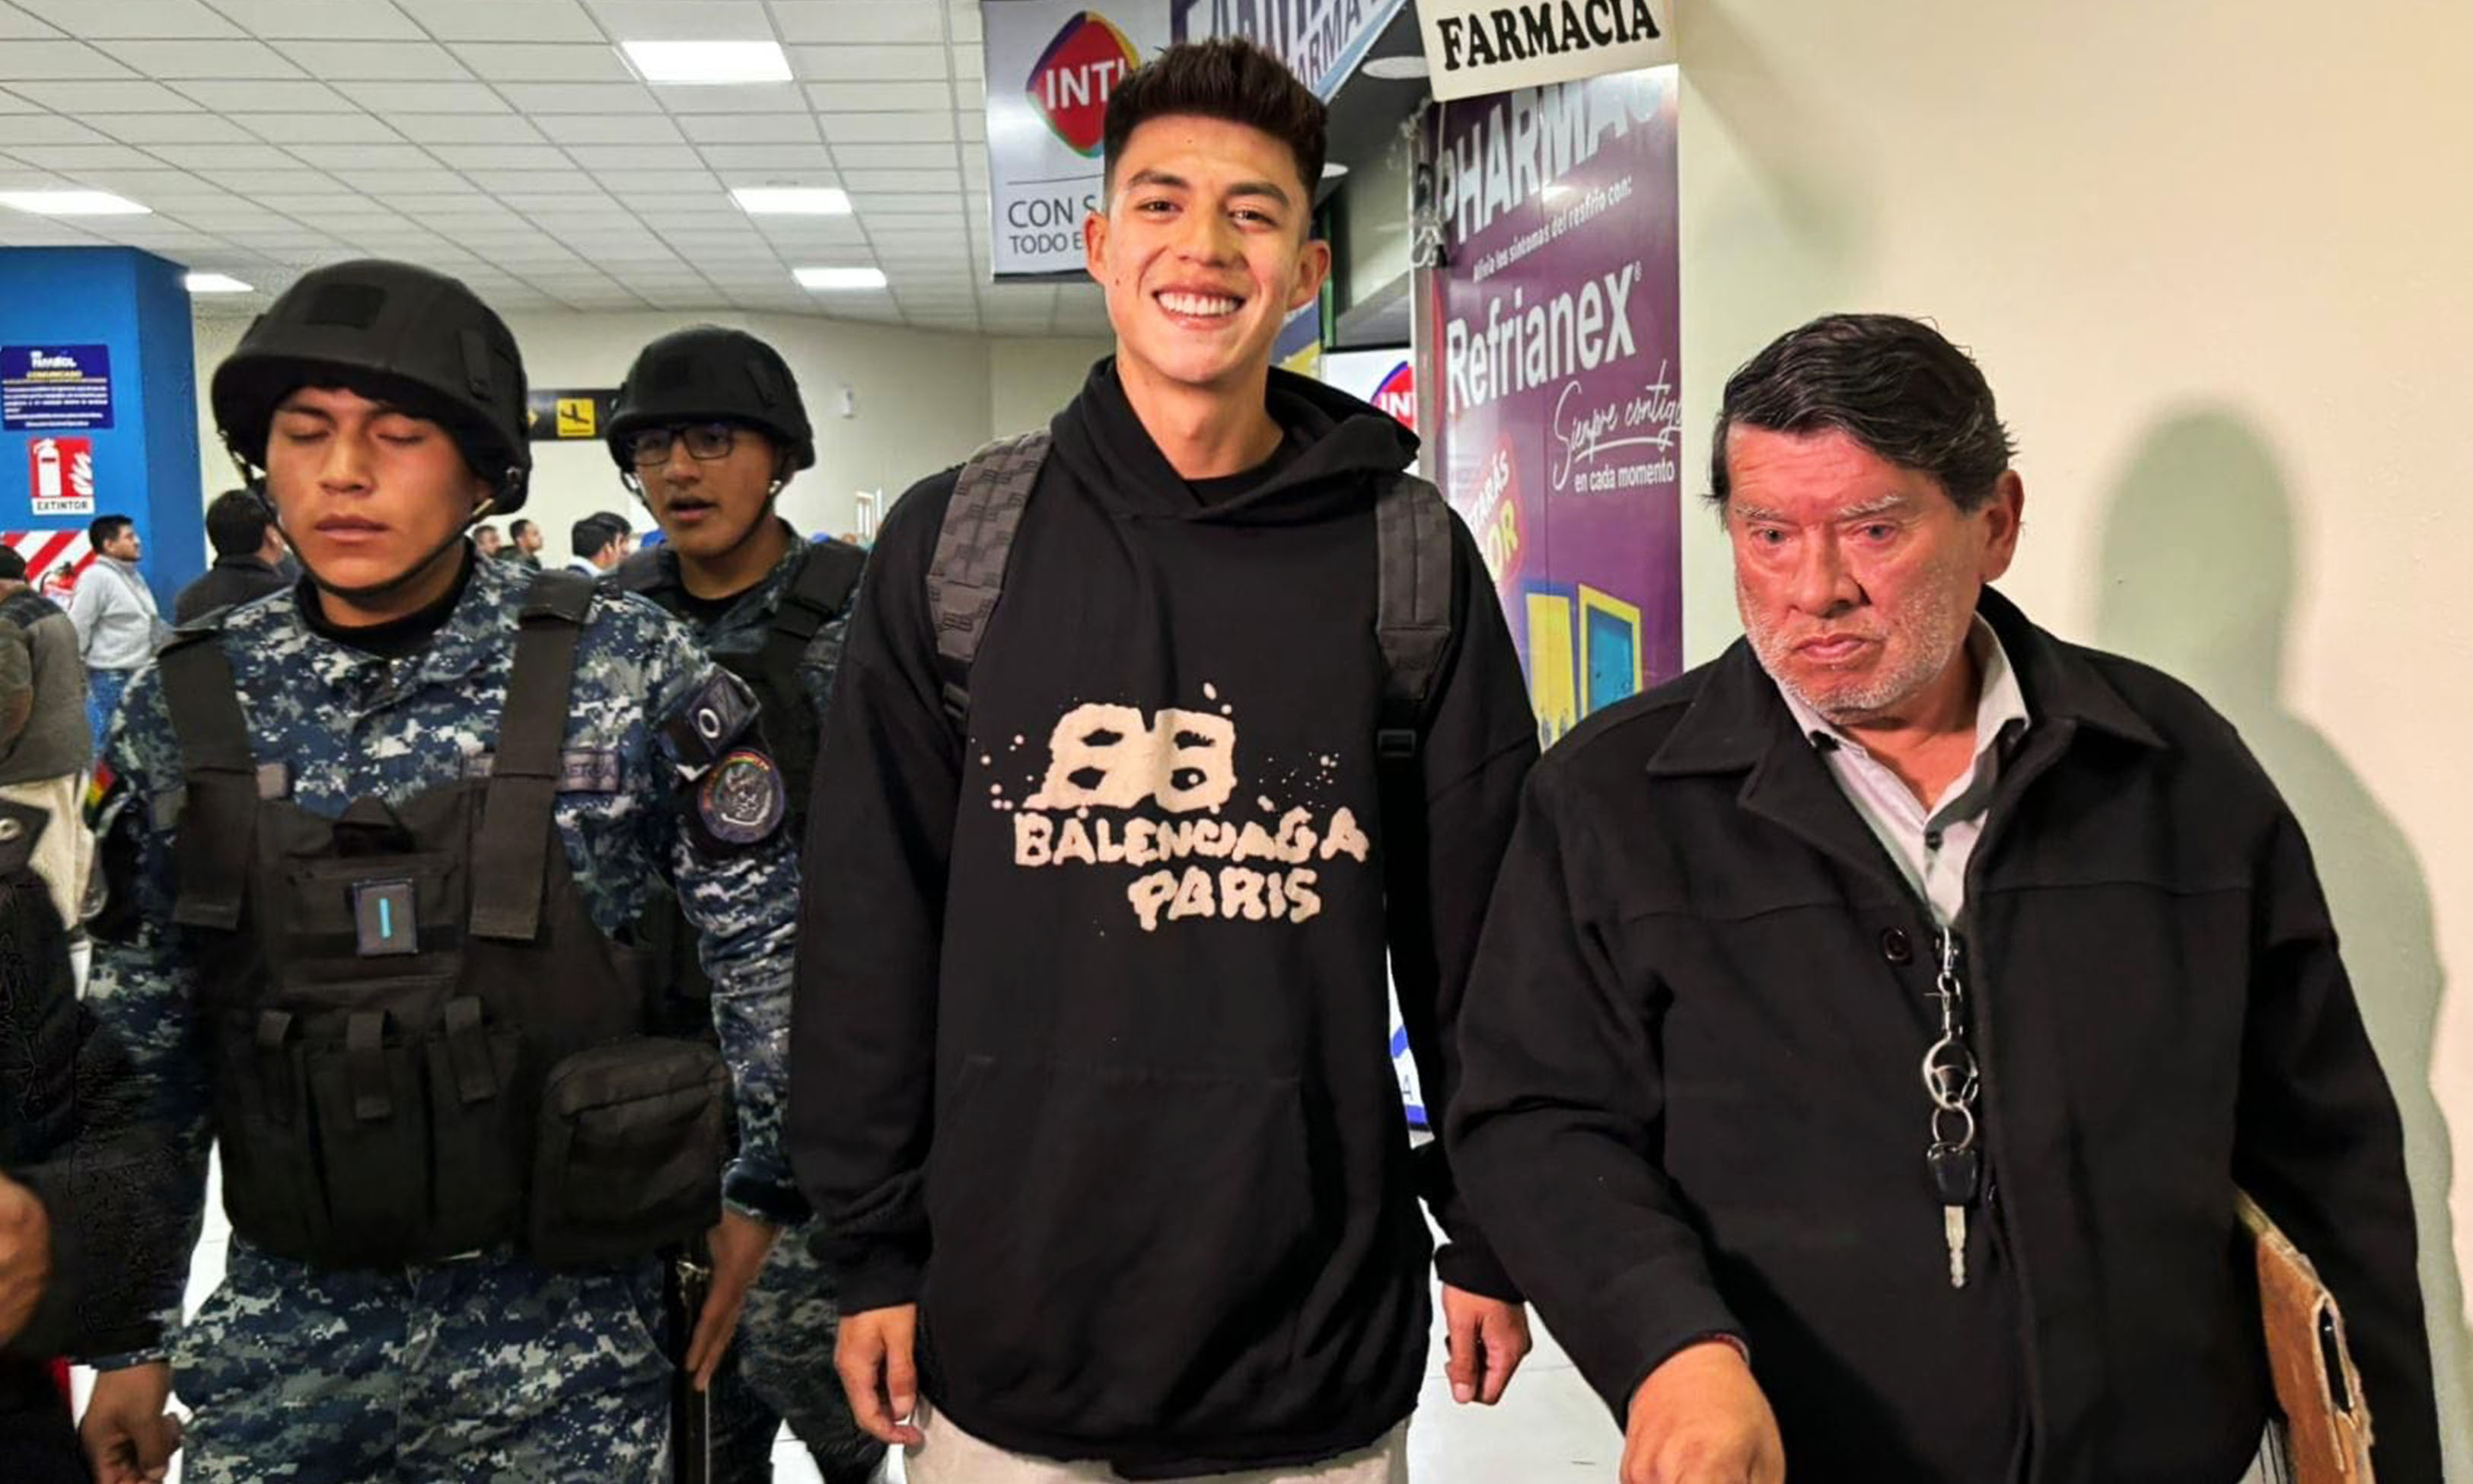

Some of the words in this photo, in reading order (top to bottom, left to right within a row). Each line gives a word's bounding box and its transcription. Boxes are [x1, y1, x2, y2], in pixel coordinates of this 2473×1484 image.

[1437, 0, 1661, 71] FARMACIA
[1046, 57, 1126, 110] INTI
[1008, 196, 1074, 228] CON
[1082, 194, 1098, 212] S
[1008, 232, 1068, 255] TODO
[1071, 230, 1085, 251] E
[1446, 263, 1636, 414] Refrianex
[1574, 472, 1589, 493] en
[1589, 463, 1616, 492] cada
[1617, 457, 1675, 489] momento
[36, 500, 88, 511] EXTINTOR
[1015, 806, 1370, 867] BALENCIAGA
[1127, 866, 1322, 931] PARIS
